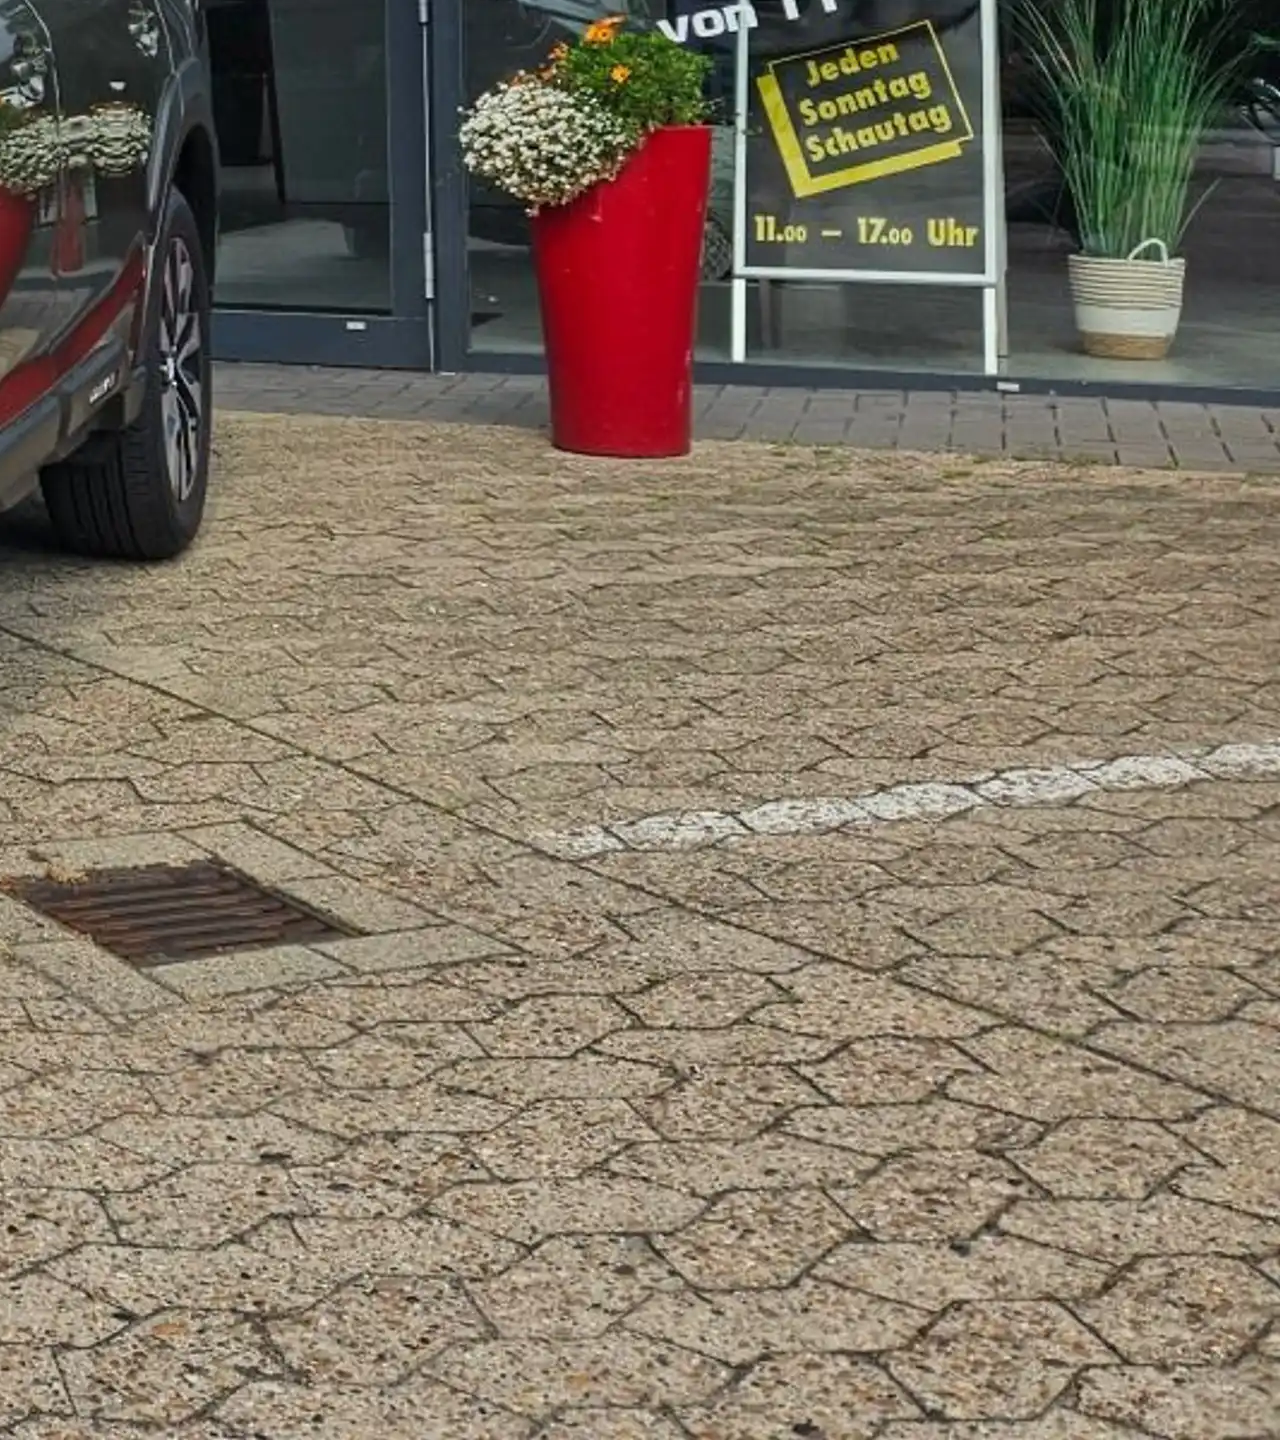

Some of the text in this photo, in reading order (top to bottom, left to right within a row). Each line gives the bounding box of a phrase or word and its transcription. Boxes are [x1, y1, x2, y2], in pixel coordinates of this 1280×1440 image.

[656, 1, 759, 44] von
[806, 40, 900, 87] Jeden
[799, 66, 933, 127] Sonntag
[805, 105, 953, 163] Schautag
[754, 215, 808, 242] 11.00
[857, 217, 914, 245] 17.00
[927, 218, 979, 247] Uhr
